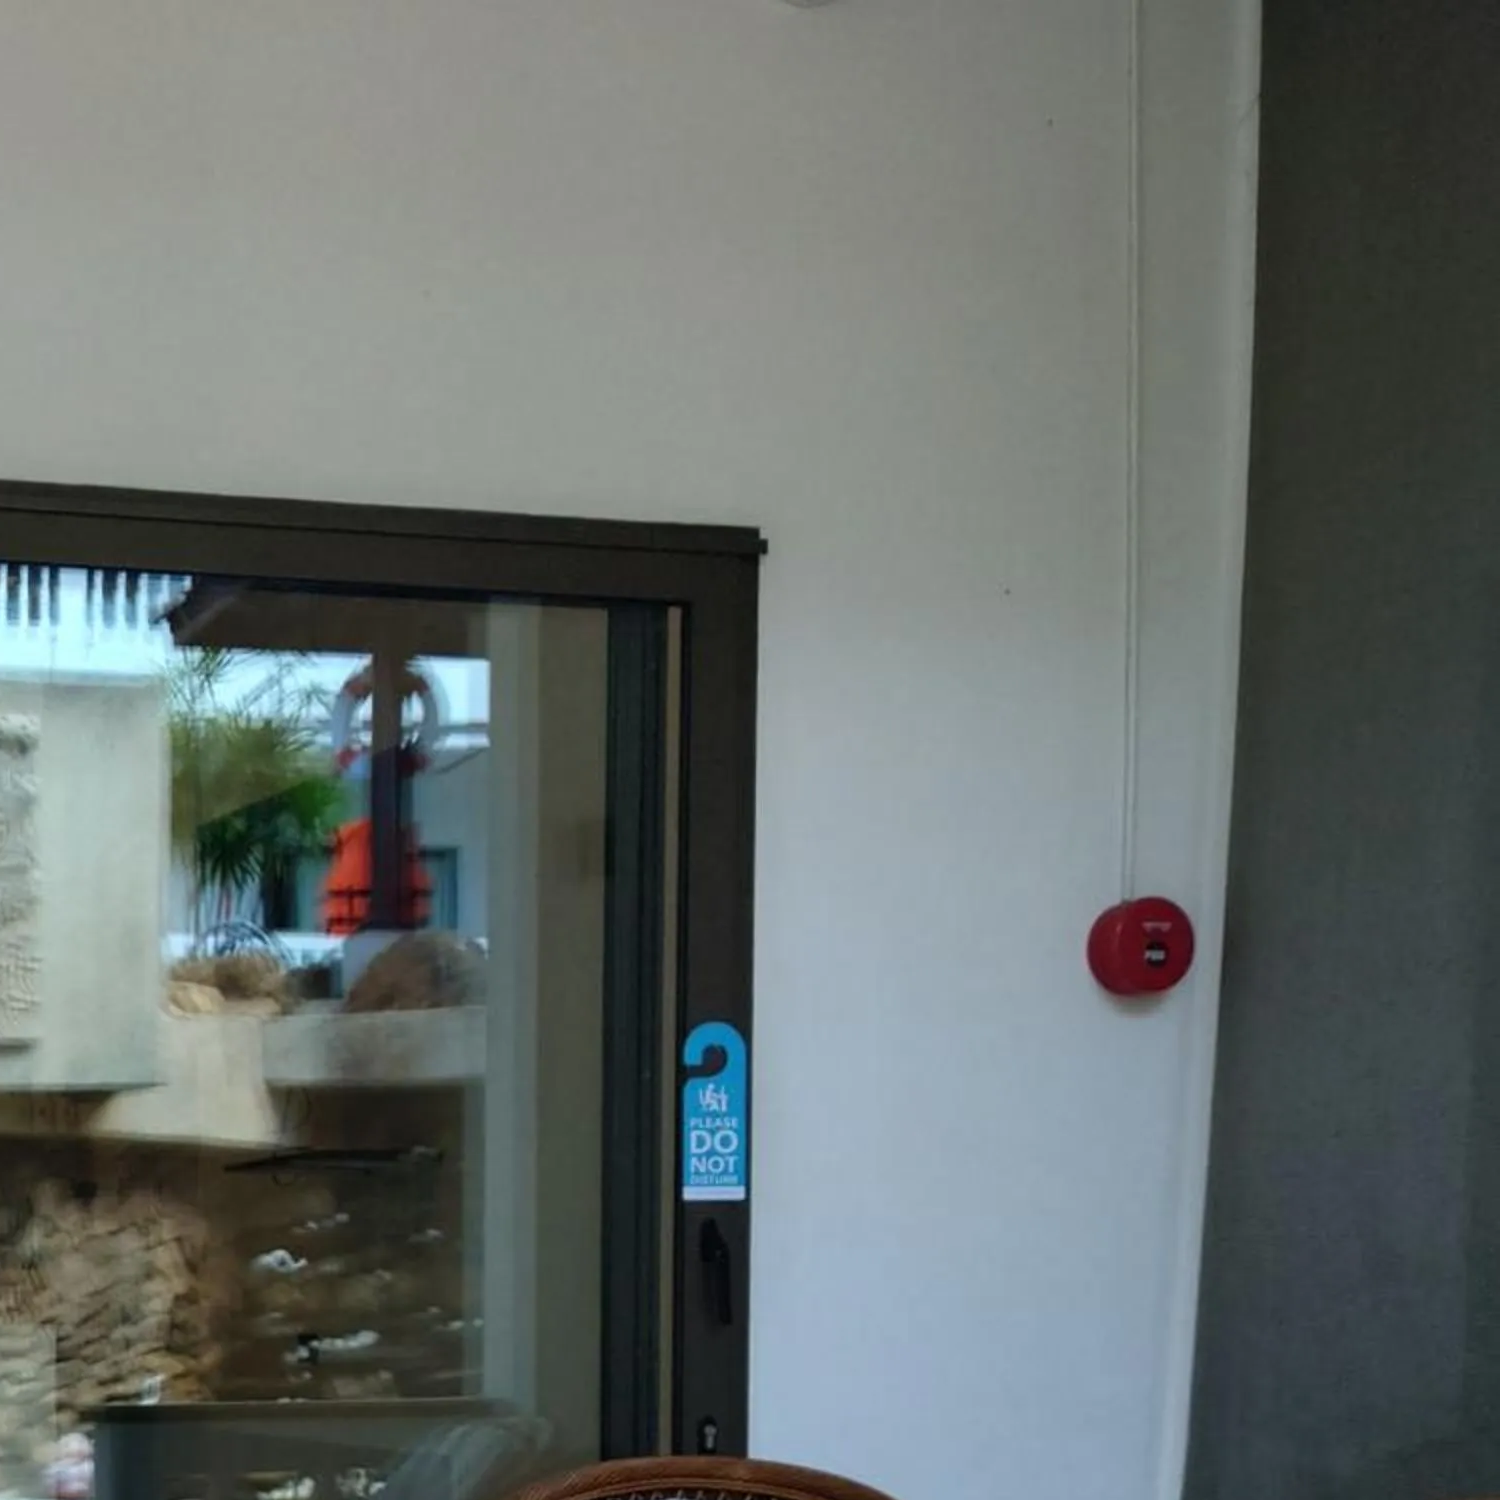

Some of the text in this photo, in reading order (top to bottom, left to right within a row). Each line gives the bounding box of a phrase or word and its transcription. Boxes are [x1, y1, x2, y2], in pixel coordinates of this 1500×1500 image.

[690, 1117, 738, 1129] PLEASE
[690, 1130, 739, 1153] DO
[690, 1156, 739, 1174] NOT
